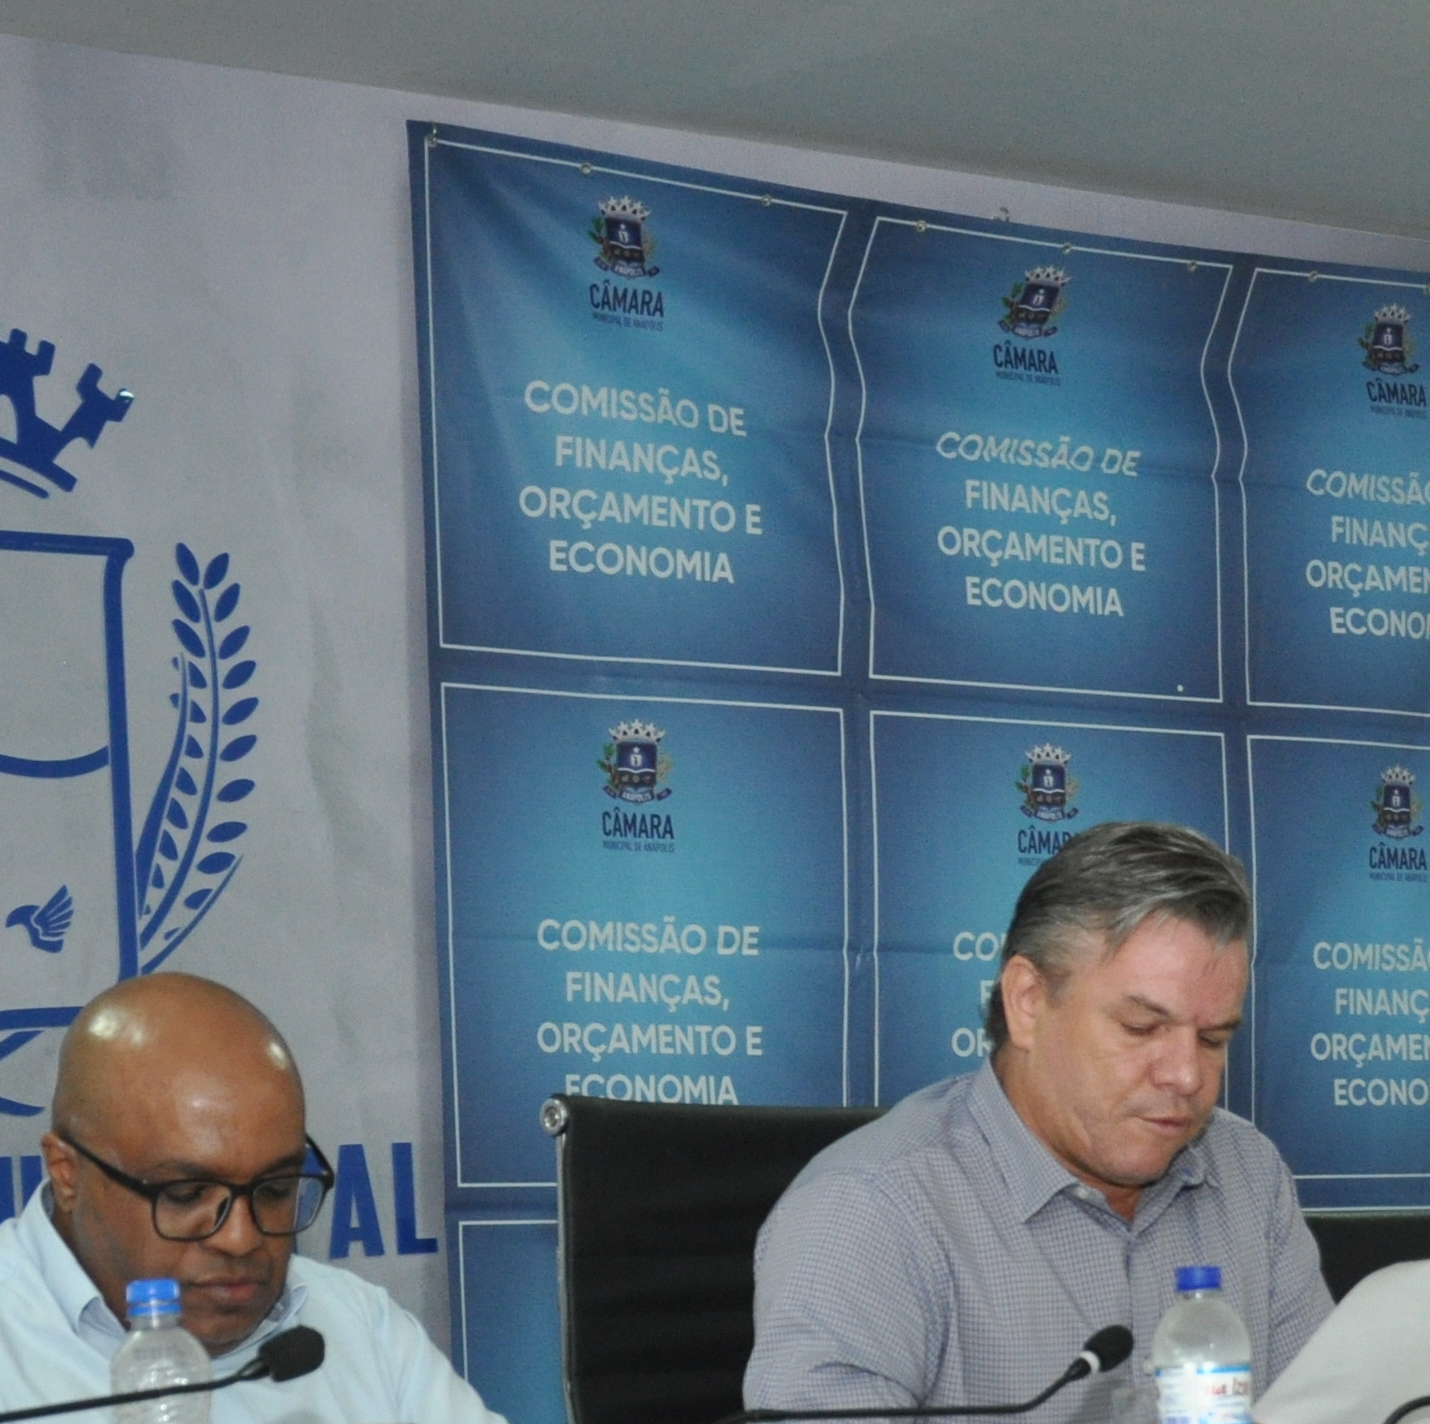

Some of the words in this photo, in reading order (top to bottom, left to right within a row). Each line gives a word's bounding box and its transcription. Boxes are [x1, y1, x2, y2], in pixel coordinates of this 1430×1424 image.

[589, 280, 664, 318] CÂMARA
[993, 339, 1059, 375] CÂMARA
[524, 379, 700, 429] COMISSÃO
[708, 403, 747, 437] DE
[1366, 377, 1427, 408] CÂMARA
[555, 434, 729, 487] FINANÇAS,
[936, 431, 1092, 473] COMISSÃO
[1101, 448, 1141, 478] DE
[519, 485, 736, 533] ORÇAMENTO
[745, 504, 763, 535] E
[965, 479, 1117, 527] FINANÇAS,
[549, 540, 735, 584] ECONOMIA
[937, 525, 1123, 570] ORÇAMENTO
[1131, 542, 1146, 572] E
[965, 576, 1124, 617] ECONOMIA
[602, 806, 675, 840] CÂMARA
[1369, 841, 1427, 871] CÂMARA
[537, 915, 707, 956] COMISSÃO
[716, 925, 760, 956] DE
[565, 971, 729, 1012] FINANÇAS,
[537, 1022, 736, 1062] ORÇAMENTO
[746, 1026, 762, 1056] E
[564, 1073, 739, 1105] ECONOMIA
